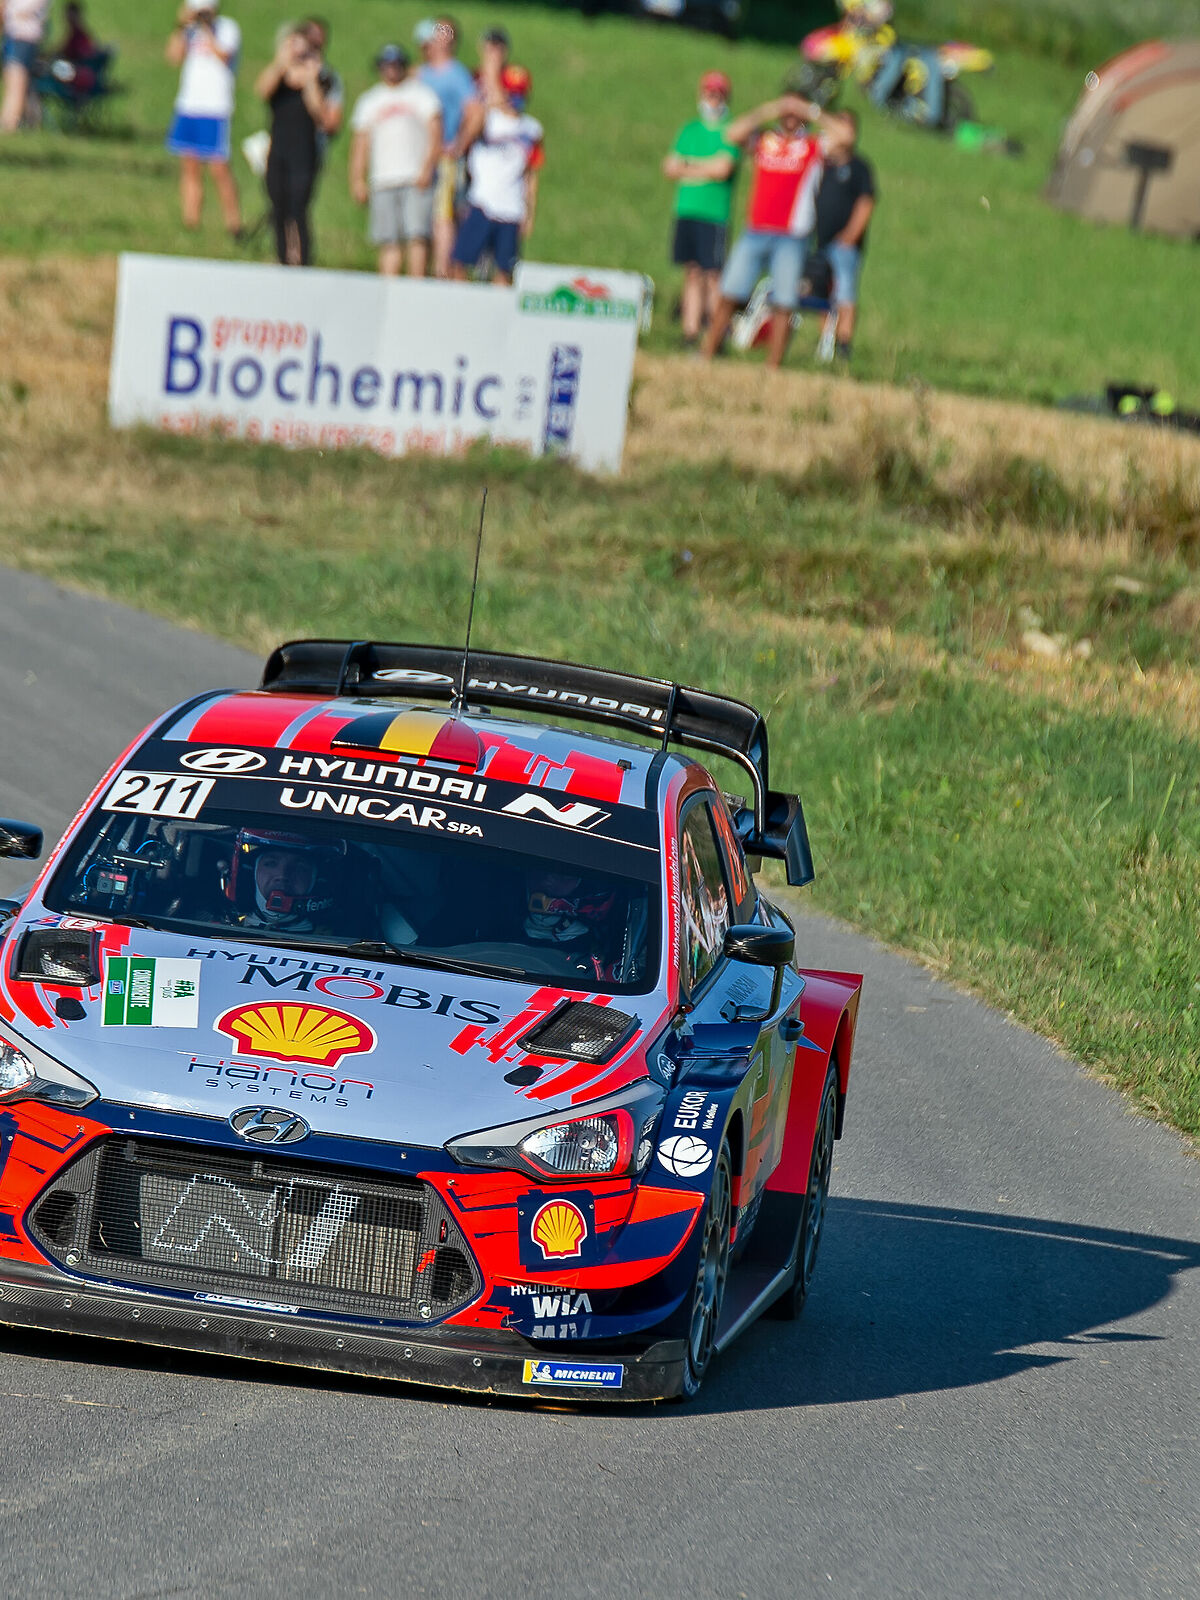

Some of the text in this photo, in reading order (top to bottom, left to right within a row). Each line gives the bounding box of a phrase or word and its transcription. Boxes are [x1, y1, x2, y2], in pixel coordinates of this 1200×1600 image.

[163, 314, 503, 421] Biochemic
[467, 676, 665, 723] HYUNDAI
[115, 774, 202, 816] 211
[279, 754, 488, 804] HYUNDAI
[278, 786, 485, 838] UNICAR SPA
[186, 948, 386, 982] HYUNDAI
[236, 963, 502, 1025] MOBIS
[187, 1057, 374, 1101] Hanon
[205, 1078, 349, 1108] SYSTEMS
[673, 1090, 710, 1130] EUKOR
[553, 1368, 617, 1381] MICHELIN
